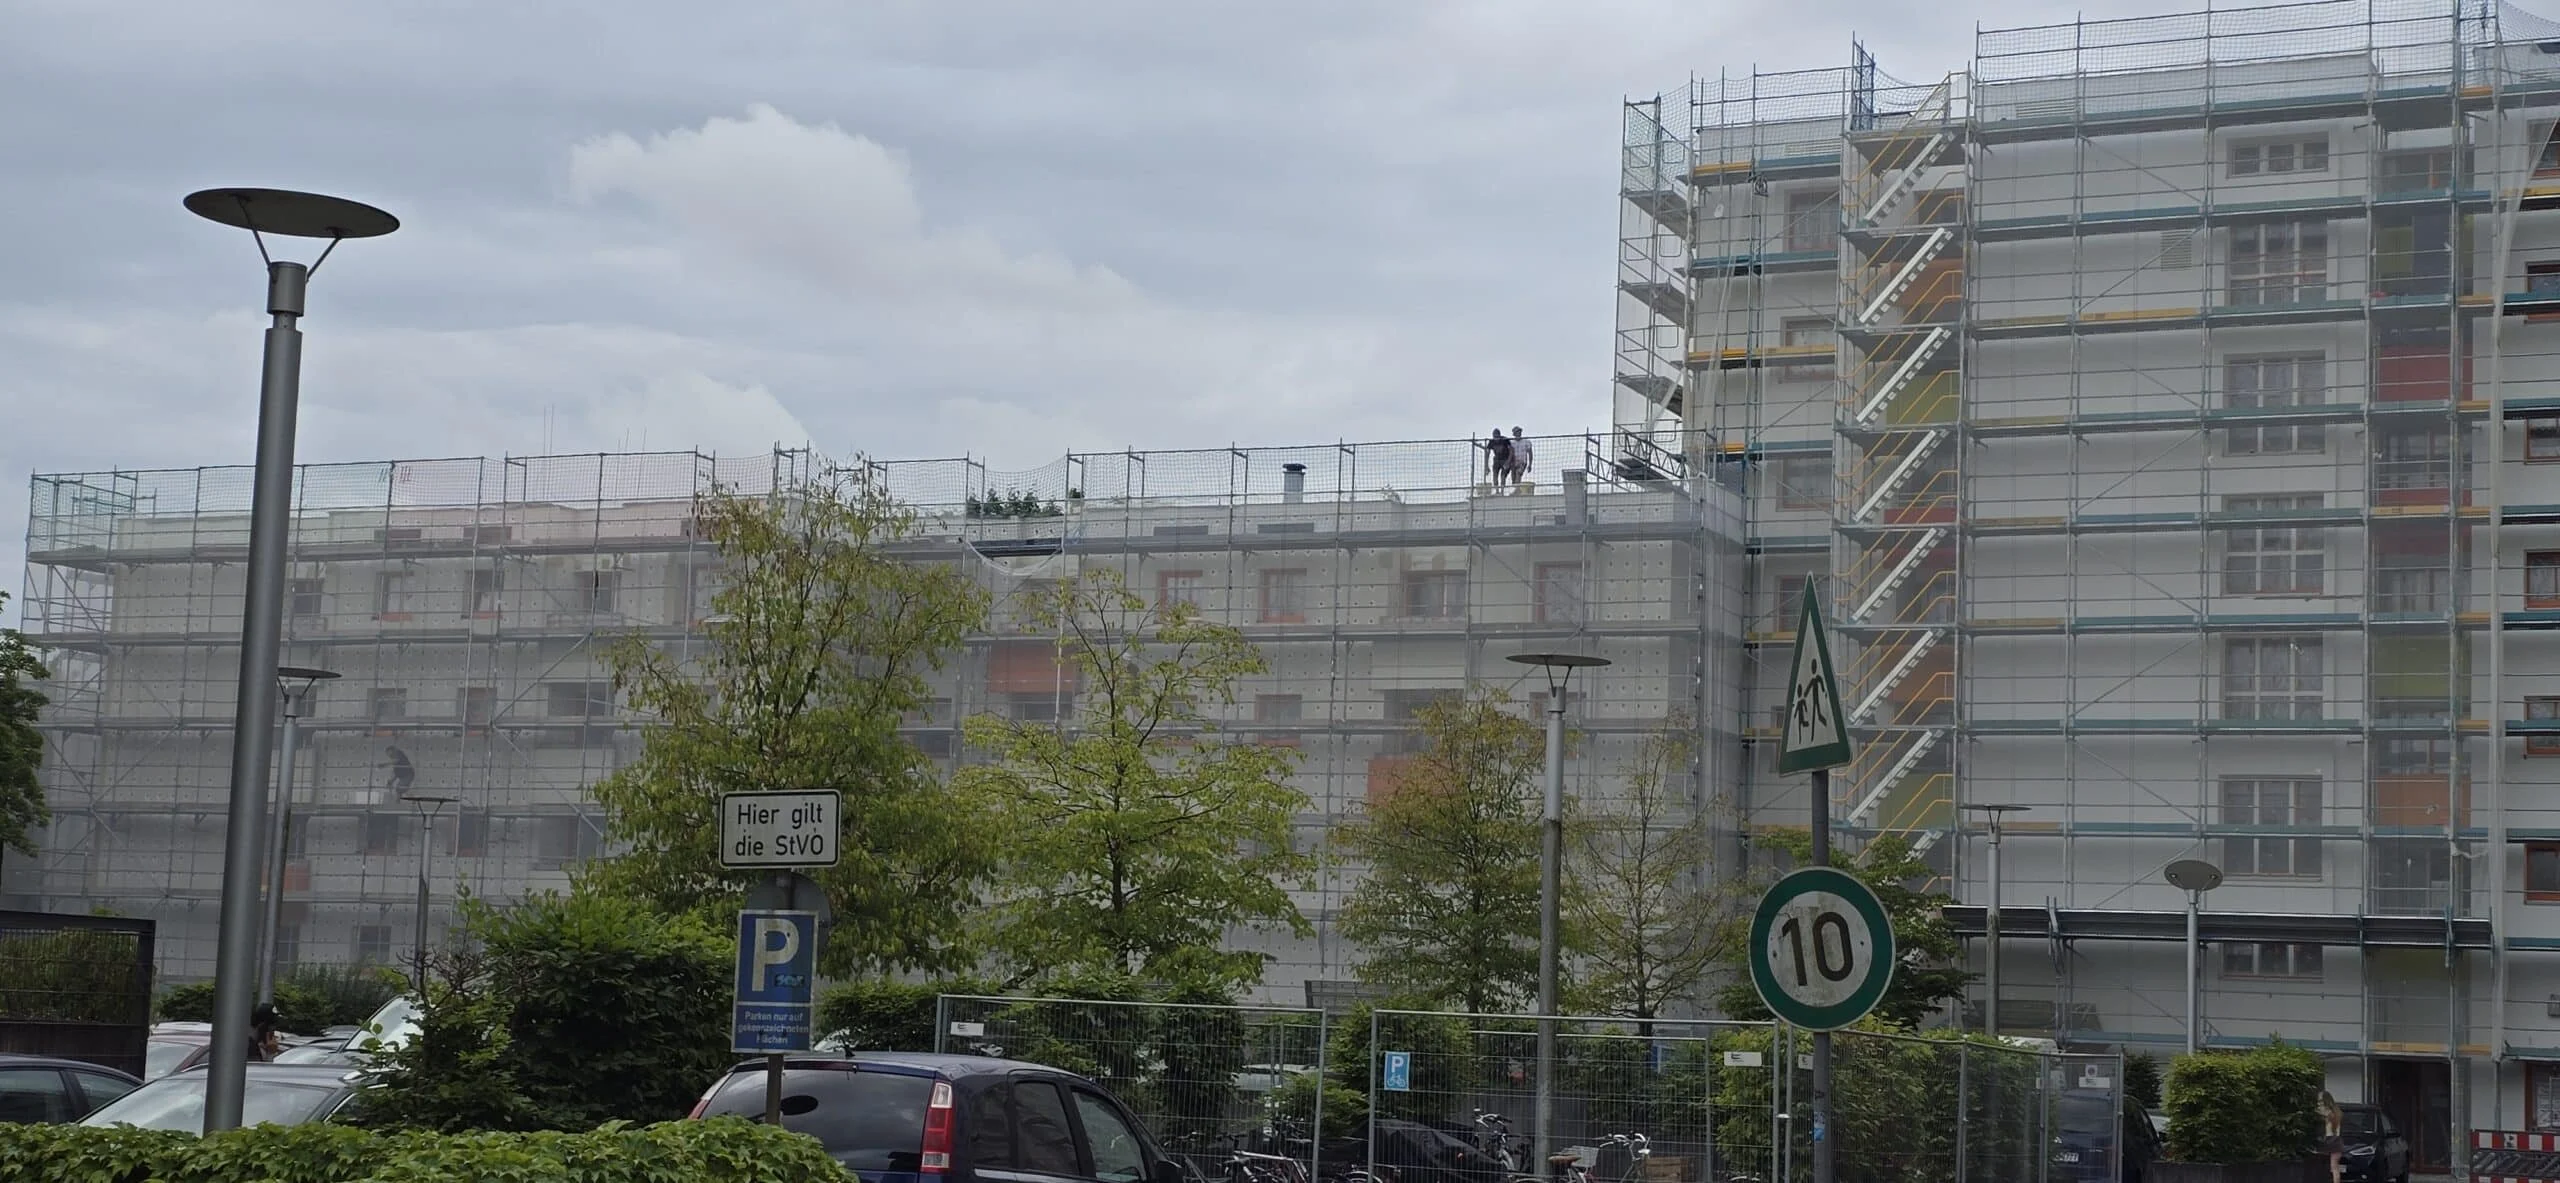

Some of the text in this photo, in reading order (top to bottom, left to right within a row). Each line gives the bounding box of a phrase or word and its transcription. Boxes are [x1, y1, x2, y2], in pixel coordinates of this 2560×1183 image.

[737, 802, 823, 830] Hier gilt
[735, 833, 824, 857] die StVO
[751, 918, 800, 992] P
[1781, 911, 1854, 987] 10
[744, 1010, 804, 1022] Parken nur auf
[1391, 1055, 1404, 1073] P
